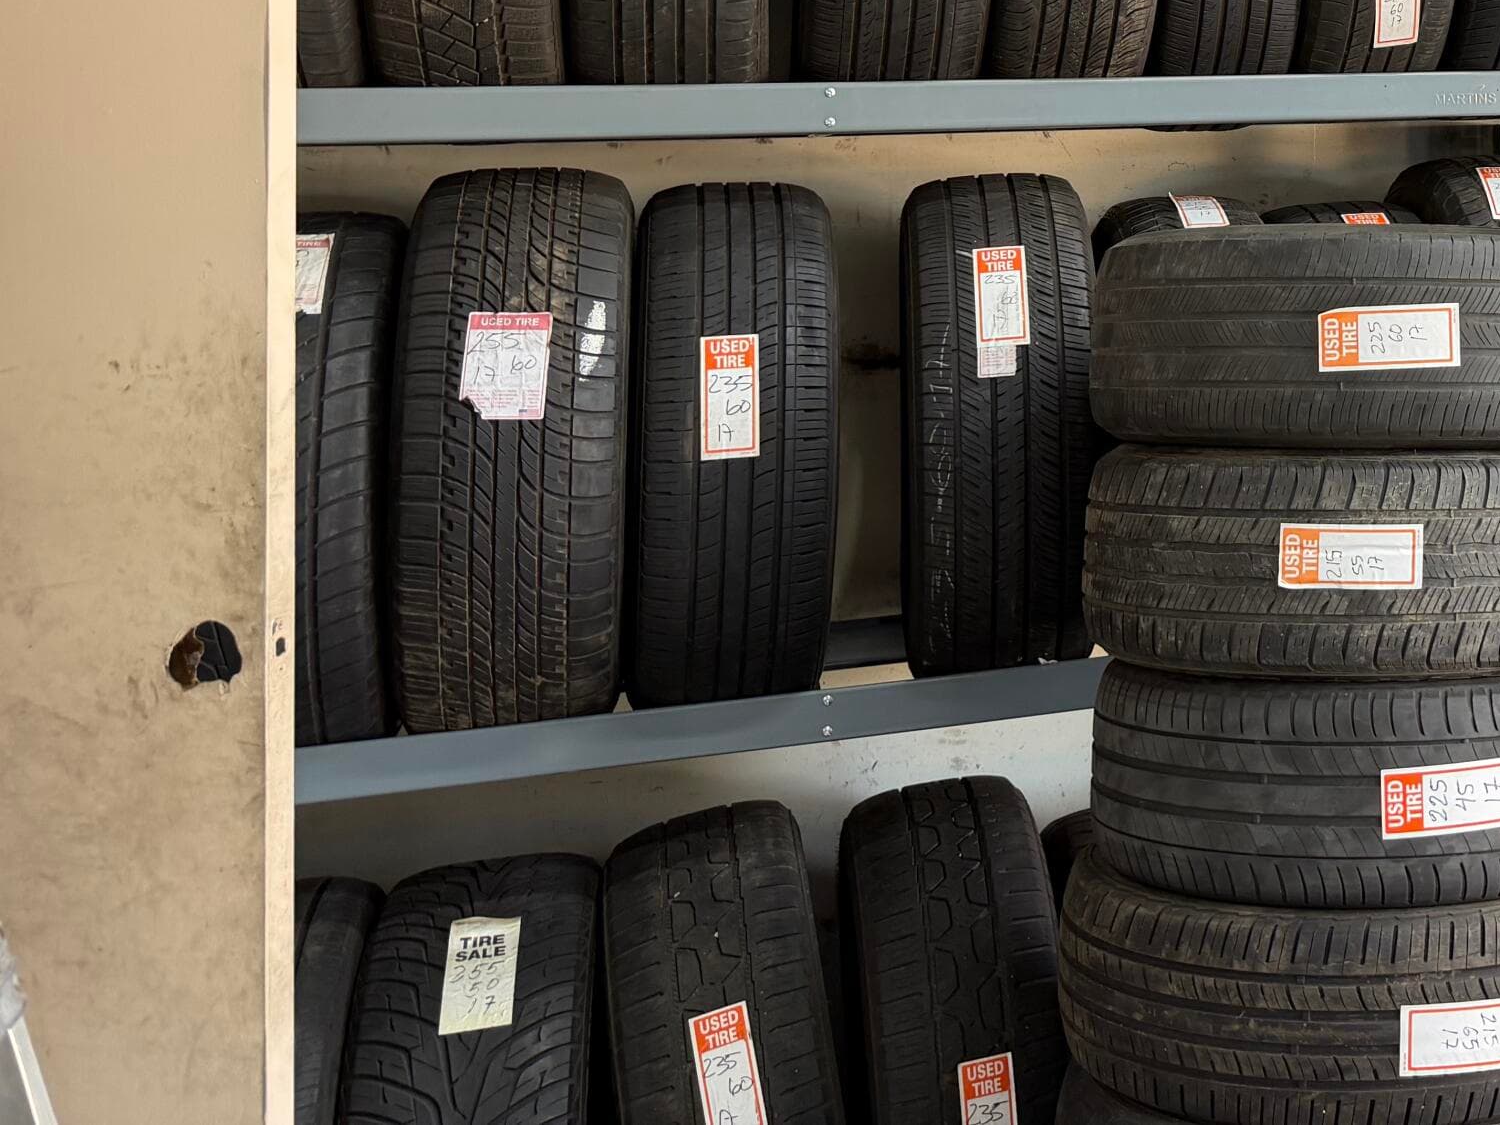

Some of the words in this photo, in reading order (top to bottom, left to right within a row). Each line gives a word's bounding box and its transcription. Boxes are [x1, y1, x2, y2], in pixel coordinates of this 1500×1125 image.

[1391, 3, 1403, 15] 60
[1391, 17, 1402, 27] 17
[1435, 93, 1496, 106] MARTINS
[982, 250, 1016, 261] USED
[985, 261, 1014, 272] TIRE
[983, 274, 1015, 285] 235
[515, 316, 540, 326] TIRE
[1323, 318, 1340, 361] USED
[1343, 321, 1357, 356] TIRE
[1370, 321, 1385, 355] 225
[1389, 325, 1403, 341] 60
[1409, 325, 1427, 340] 17
[468, 331, 520, 354] 255
[710, 340, 750, 354] USED
[511, 354, 536, 371] 60
[712, 353, 745, 368] TIRE
[710, 375, 752, 393] 235
[725, 400, 750, 415] 60
[717, 424, 734, 442] 17
[1284, 534, 1300, 576] USED
[1302, 538, 1318, 574] TIRE
[1368, 555, 1384, 570] 17
[1326, 550, 1342, 579] 215
[1352, 555, 1364, 575] 55
[1387, 780, 1404, 827] USED
[1406, 784, 1422, 819] TIRE
[1429, 779, 1447, 822] 225
[1455, 781, 1473, 811] 45
[461, 935, 506, 949] TIRE
[456, 947, 506, 962] SALE
[471, 979, 500, 994] 50
[700, 1011, 738, 1034] USED
[1481, 1013, 1498, 1045] 215
[705, 1027, 737, 1047] TIRE
[1442, 1029, 1458, 1050] 17
[1462, 1026, 1478, 1050] 65
[704, 1052, 740, 1078] 235
[967, 1062, 1003, 1081] USED
[728, 1077, 752, 1095] 60
[974, 1079, 1001, 1096] TIRE
[968, 1102, 1007, 1125] 235
